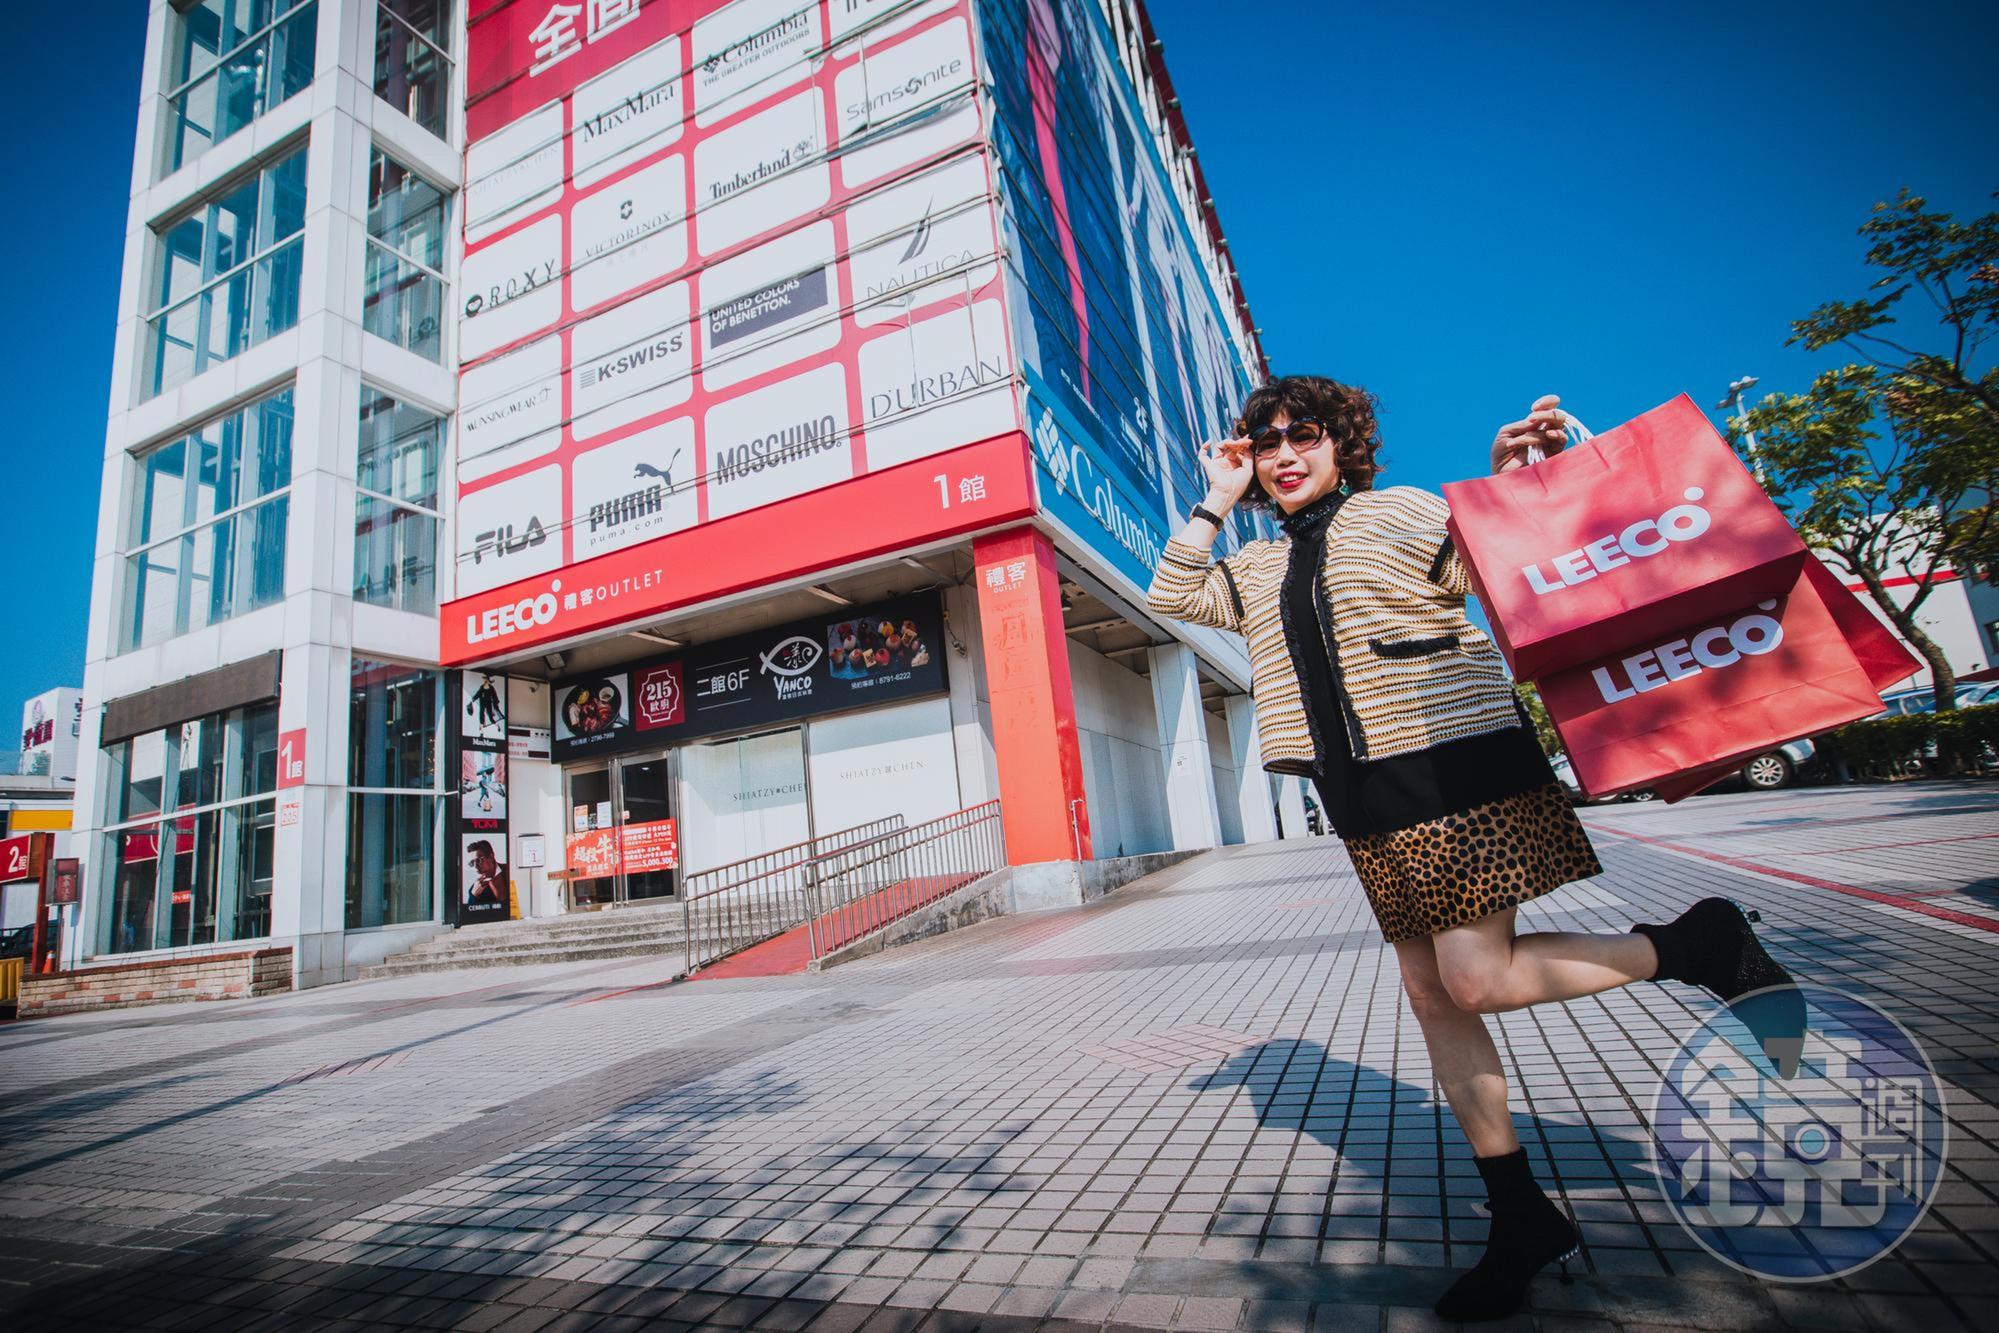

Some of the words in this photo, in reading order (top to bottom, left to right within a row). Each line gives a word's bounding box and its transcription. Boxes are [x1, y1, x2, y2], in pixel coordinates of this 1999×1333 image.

[722, 10, 808, 62] Columbia
[703, 75, 720, 87] THE
[846, 59, 961, 121] Samsonite
[709, 149, 791, 199] Timberland
[585, 211, 671, 257] VICTORINOX
[489, 259, 555, 308] ROXY
[711, 298, 752, 321] UNITED
[754, 279, 800, 305] COLORS
[867, 250, 975, 301] NAUTICA
[712, 319, 727, 333] OF
[717, 415, 837, 486] MOSCHINO
[590, 484, 662, 533] PUMA
[1070, 444, 1161, 575] Columbi
[474, 515, 547, 565] FILA
[1522, 486, 1711, 596] LEECO
[985, 561, 1027, 588] 禮客
[993, 581, 1023, 594] OUTLET
[467, 579, 562, 644] LEECO
[1591, 598, 1784, 704] LEECO
[646, 680, 673, 701] 215
[773, 676, 812, 700] YANCO
